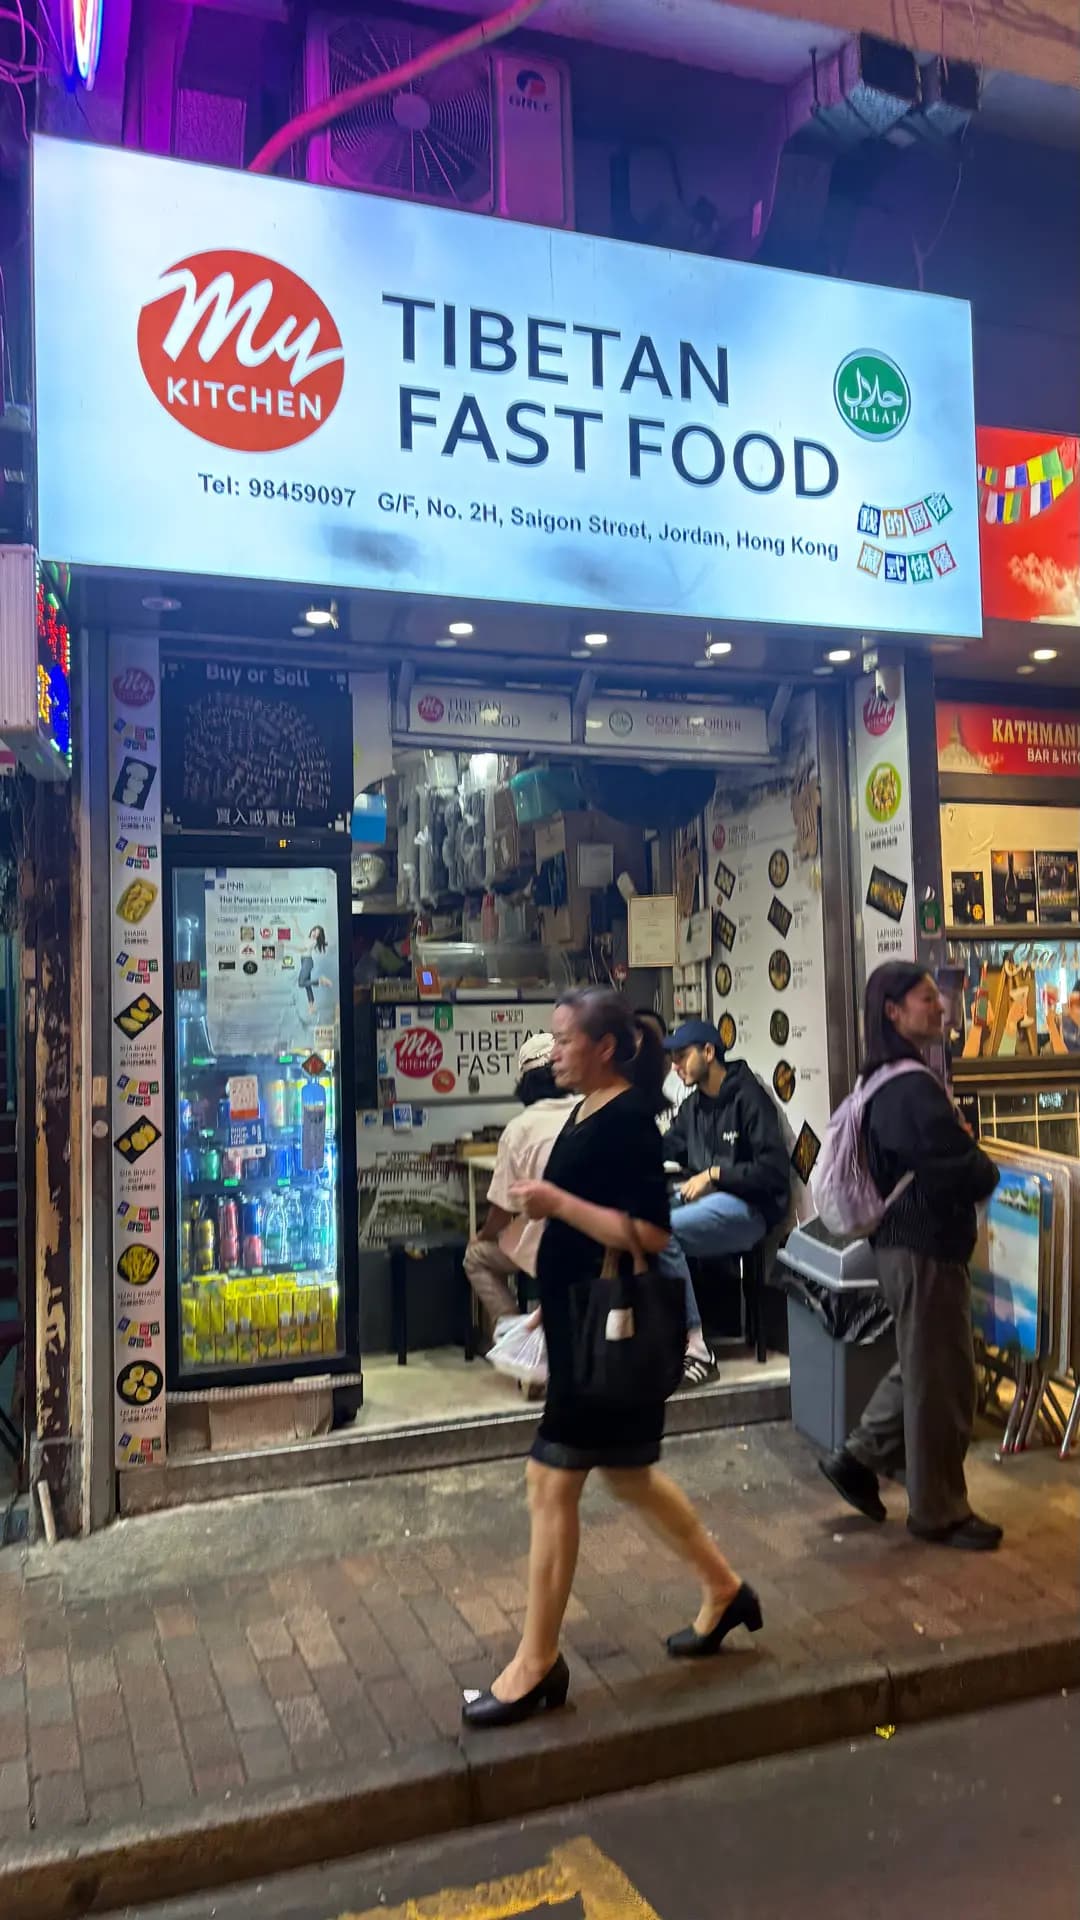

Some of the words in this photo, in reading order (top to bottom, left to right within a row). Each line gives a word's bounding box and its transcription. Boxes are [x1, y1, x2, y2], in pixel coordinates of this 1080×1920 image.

[145, 268, 344, 386] My
[382, 291, 729, 407] TIBETAN
[166, 376, 322, 421] KITCHEN
[851, 405, 900, 426] HALAL
[400, 384, 603, 473] FAST
[629, 414, 839, 499] FOOD
[199, 472, 239, 496] Tel:
[249, 478, 356, 508] 98459097
[378, 492, 419, 520] G/F,
[427, 498, 462, 520] No.
[470, 501, 504, 528] 2H,
[511, 507, 581, 535] Saigon
[588, 515, 652, 542] Street,
[658, 523, 730, 551] Jordan,
[736, 529, 785, 556] Hong
[791, 536, 838, 562] Kong
[206, 663, 241, 686] Buy
[247, 671, 267, 684] or
[273, 668, 311, 687] Sell
[1027, 747, 1050, 764] BAR
[456, 1053, 515, 1077] FAST
